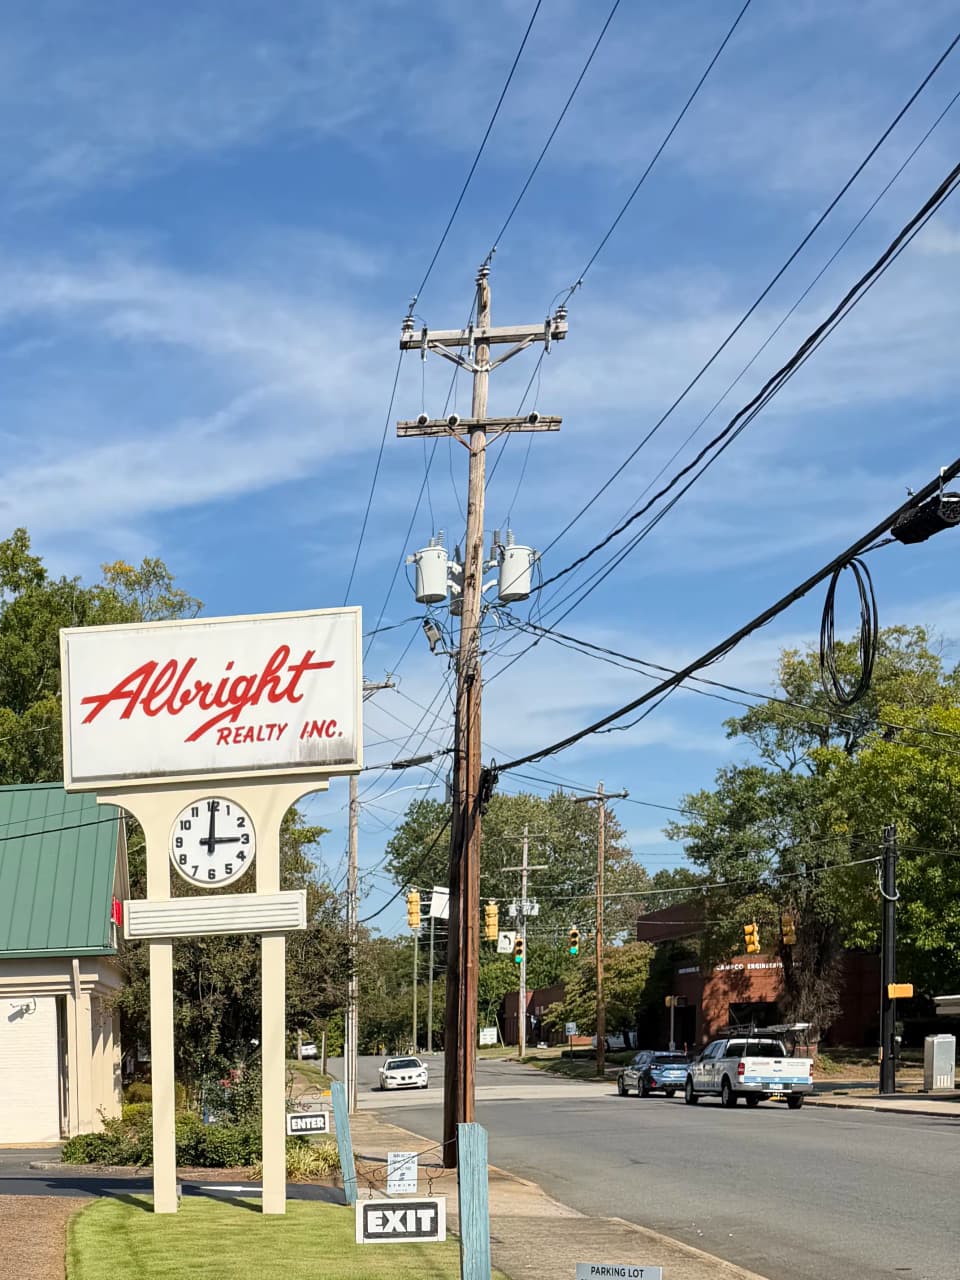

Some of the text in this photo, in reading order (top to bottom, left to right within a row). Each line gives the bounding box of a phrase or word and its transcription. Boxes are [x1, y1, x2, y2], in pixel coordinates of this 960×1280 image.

[80, 644, 335, 742] Albright
[216, 719, 343, 746] REALTY INC.
[207, 801, 220, 812] 12
[226, 805, 230, 816] 1
[191, 807, 199, 818] 11
[180, 820, 191, 831] 10
[237, 817, 245, 828] 2
[175, 837, 183, 848] 9
[241, 833, 250, 844] 3
[179, 854, 187, 865] 8
[236, 850, 246, 862] 4
[191, 865, 199, 877] 7
[208, 869, 216, 880] 6
[225, 863, 233, 875] 5
[291, 1117, 324, 1130] ENTER
[367, 1209, 435, 1233] EXIT
[590, 1266, 645, 1278] PARKING LOT
